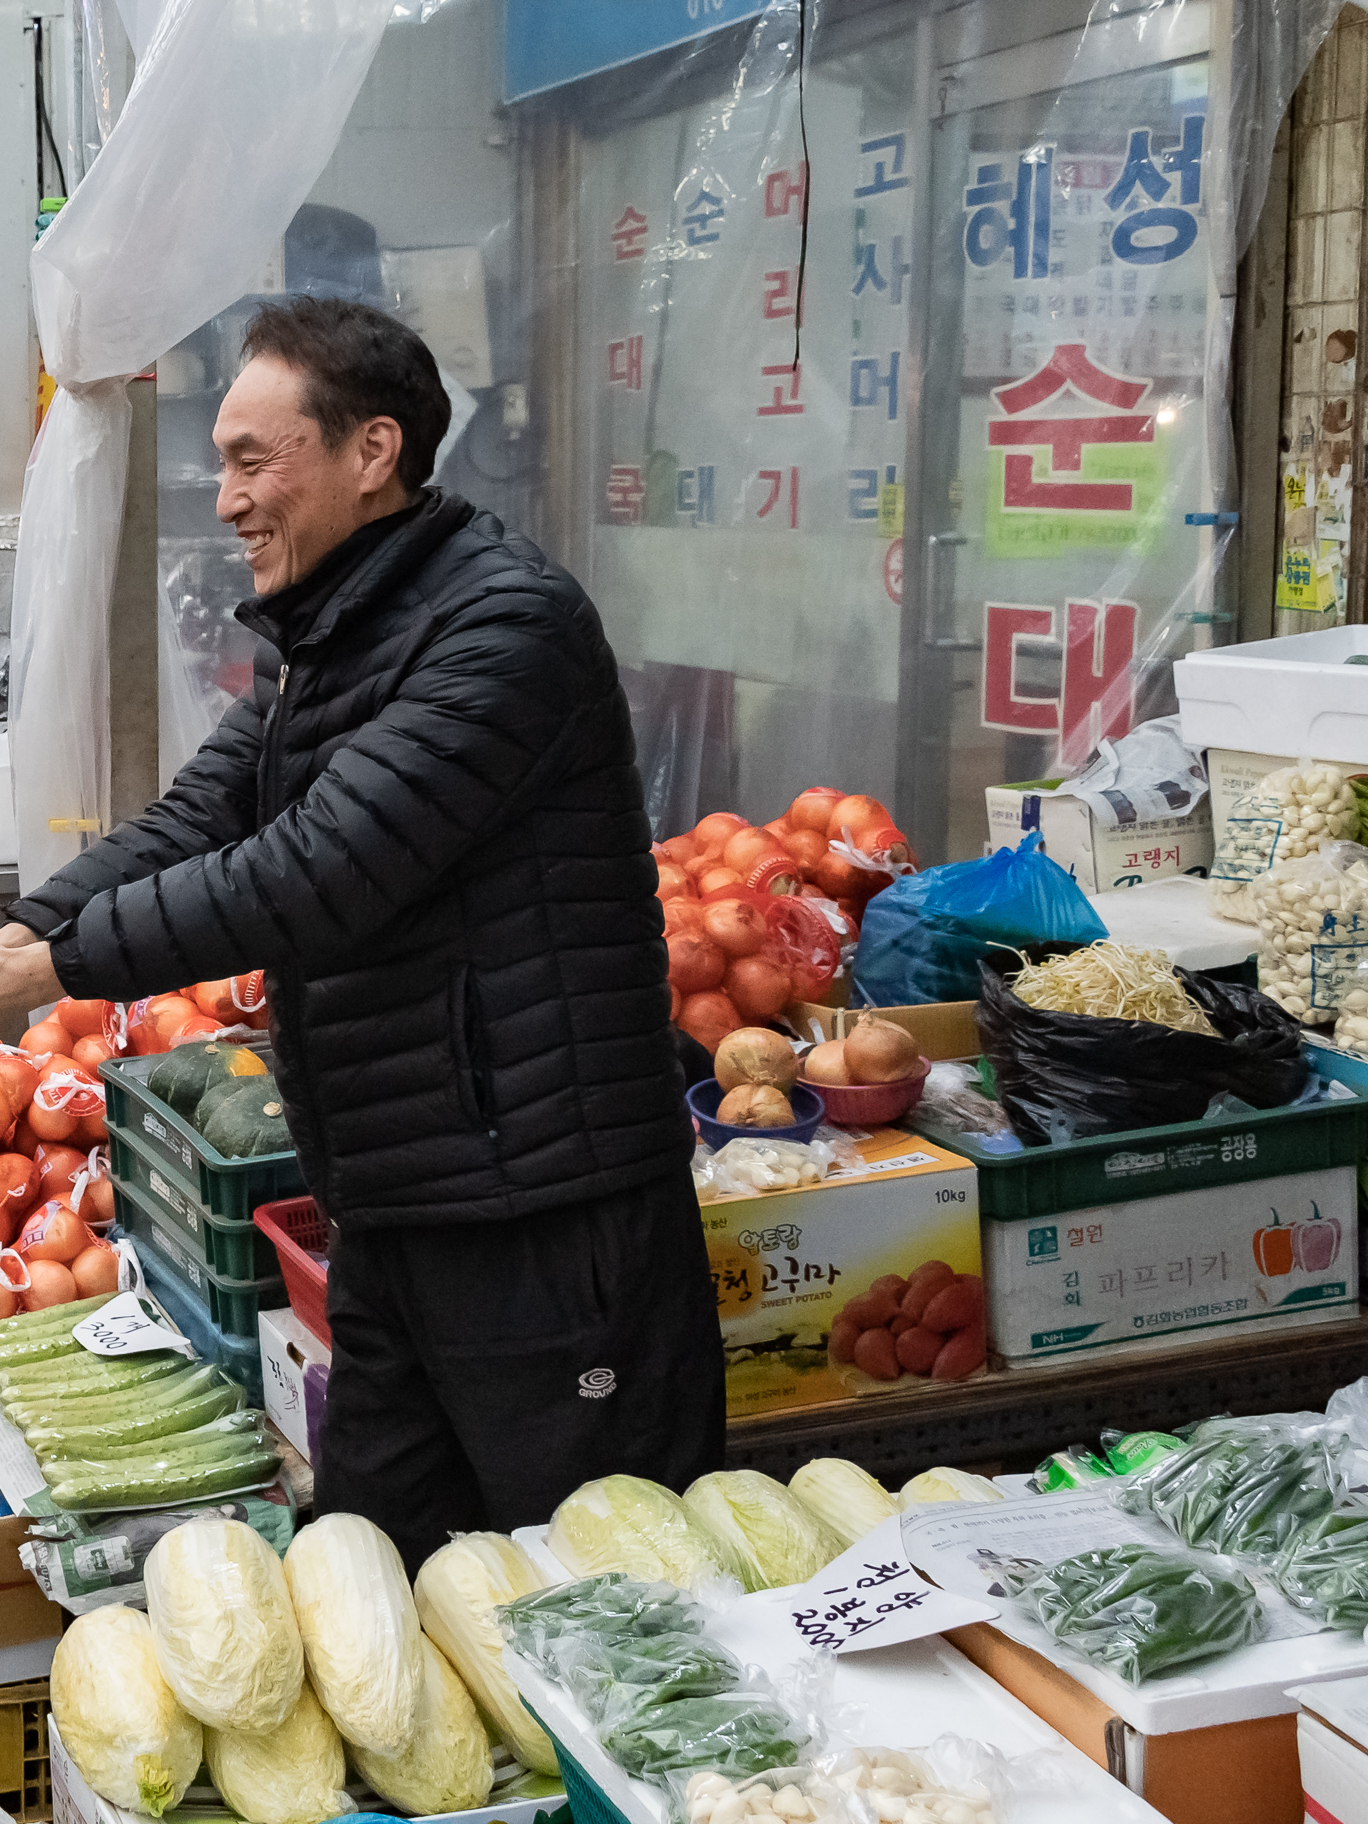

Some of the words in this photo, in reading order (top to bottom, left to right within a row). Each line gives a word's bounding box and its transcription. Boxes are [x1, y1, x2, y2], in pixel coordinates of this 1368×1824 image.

[963, 114, 1206, 281] 혜성
[757, 160, 810, 531] 머리고기
[606, 205, 649, 526] 순대국
[979, 342, 1157, 769] 순대
[1121, 845, 1180, 870] 고랭지
[934, 1188, 966, 1204] 10kg
[761, 1255, 842, 1294] 고구마
[1098, 1250, 1229, 1299] 파프리카
[761, 1295, 794, 1310] SWEET
[796, 1290, 833, 1305] POTATO
[79, 1321, 128, 1350] 3000
[1041, 1331, 1065, 1346] NH
[577, 1381, 618, 1399] GROUND
[856, 1561, 931, 1614] 청양
